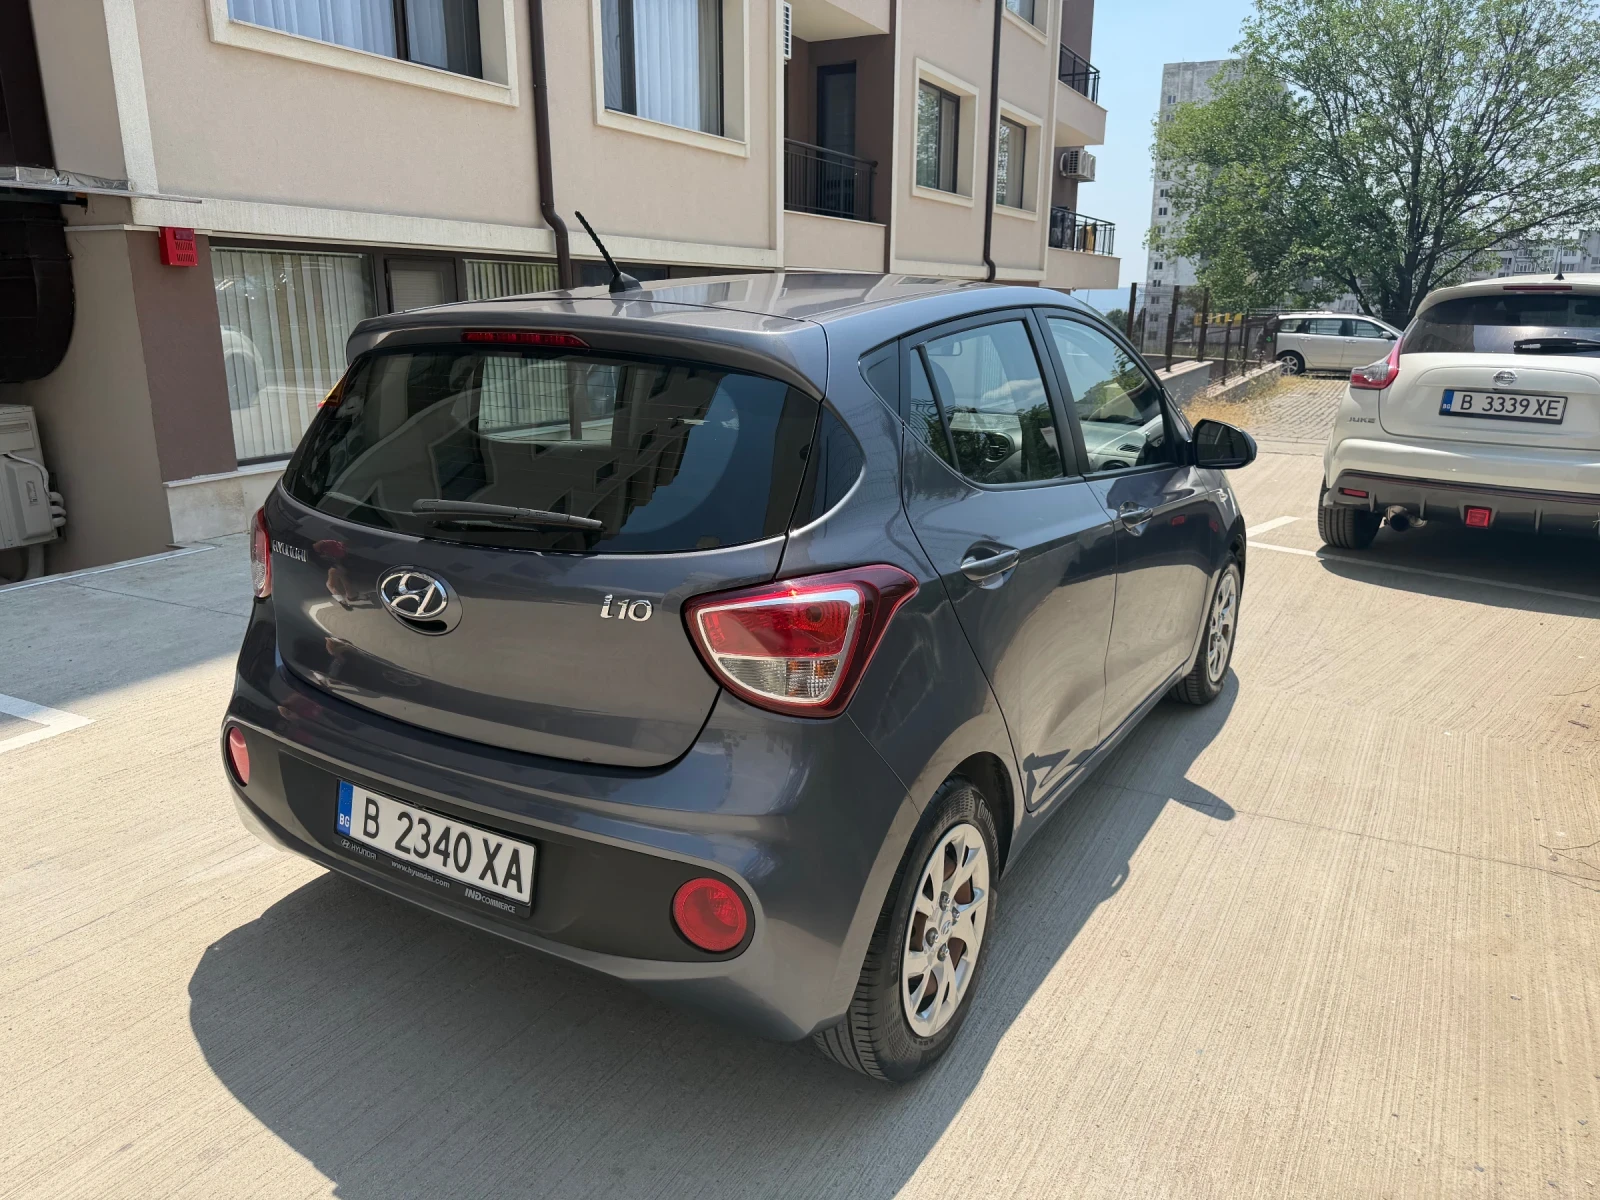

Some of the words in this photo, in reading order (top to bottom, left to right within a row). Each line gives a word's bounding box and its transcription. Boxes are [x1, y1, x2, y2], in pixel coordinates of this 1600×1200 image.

[1460, 394, 1473, 410] B
[1482, 396, 1530, 414] 3339
[1532, 399, 1560, 416] XE
[600, 594, 652, 621] i10
[339, 813, 350, 828] BG
[351, 843, 378, 860] HYUNDAI
[363, 797, 380, 839] B
[395, 811, 472, 874] 2340
[479, 837, 523, 894] XA
[391, 860, 450, 888] www.hyundai.com
